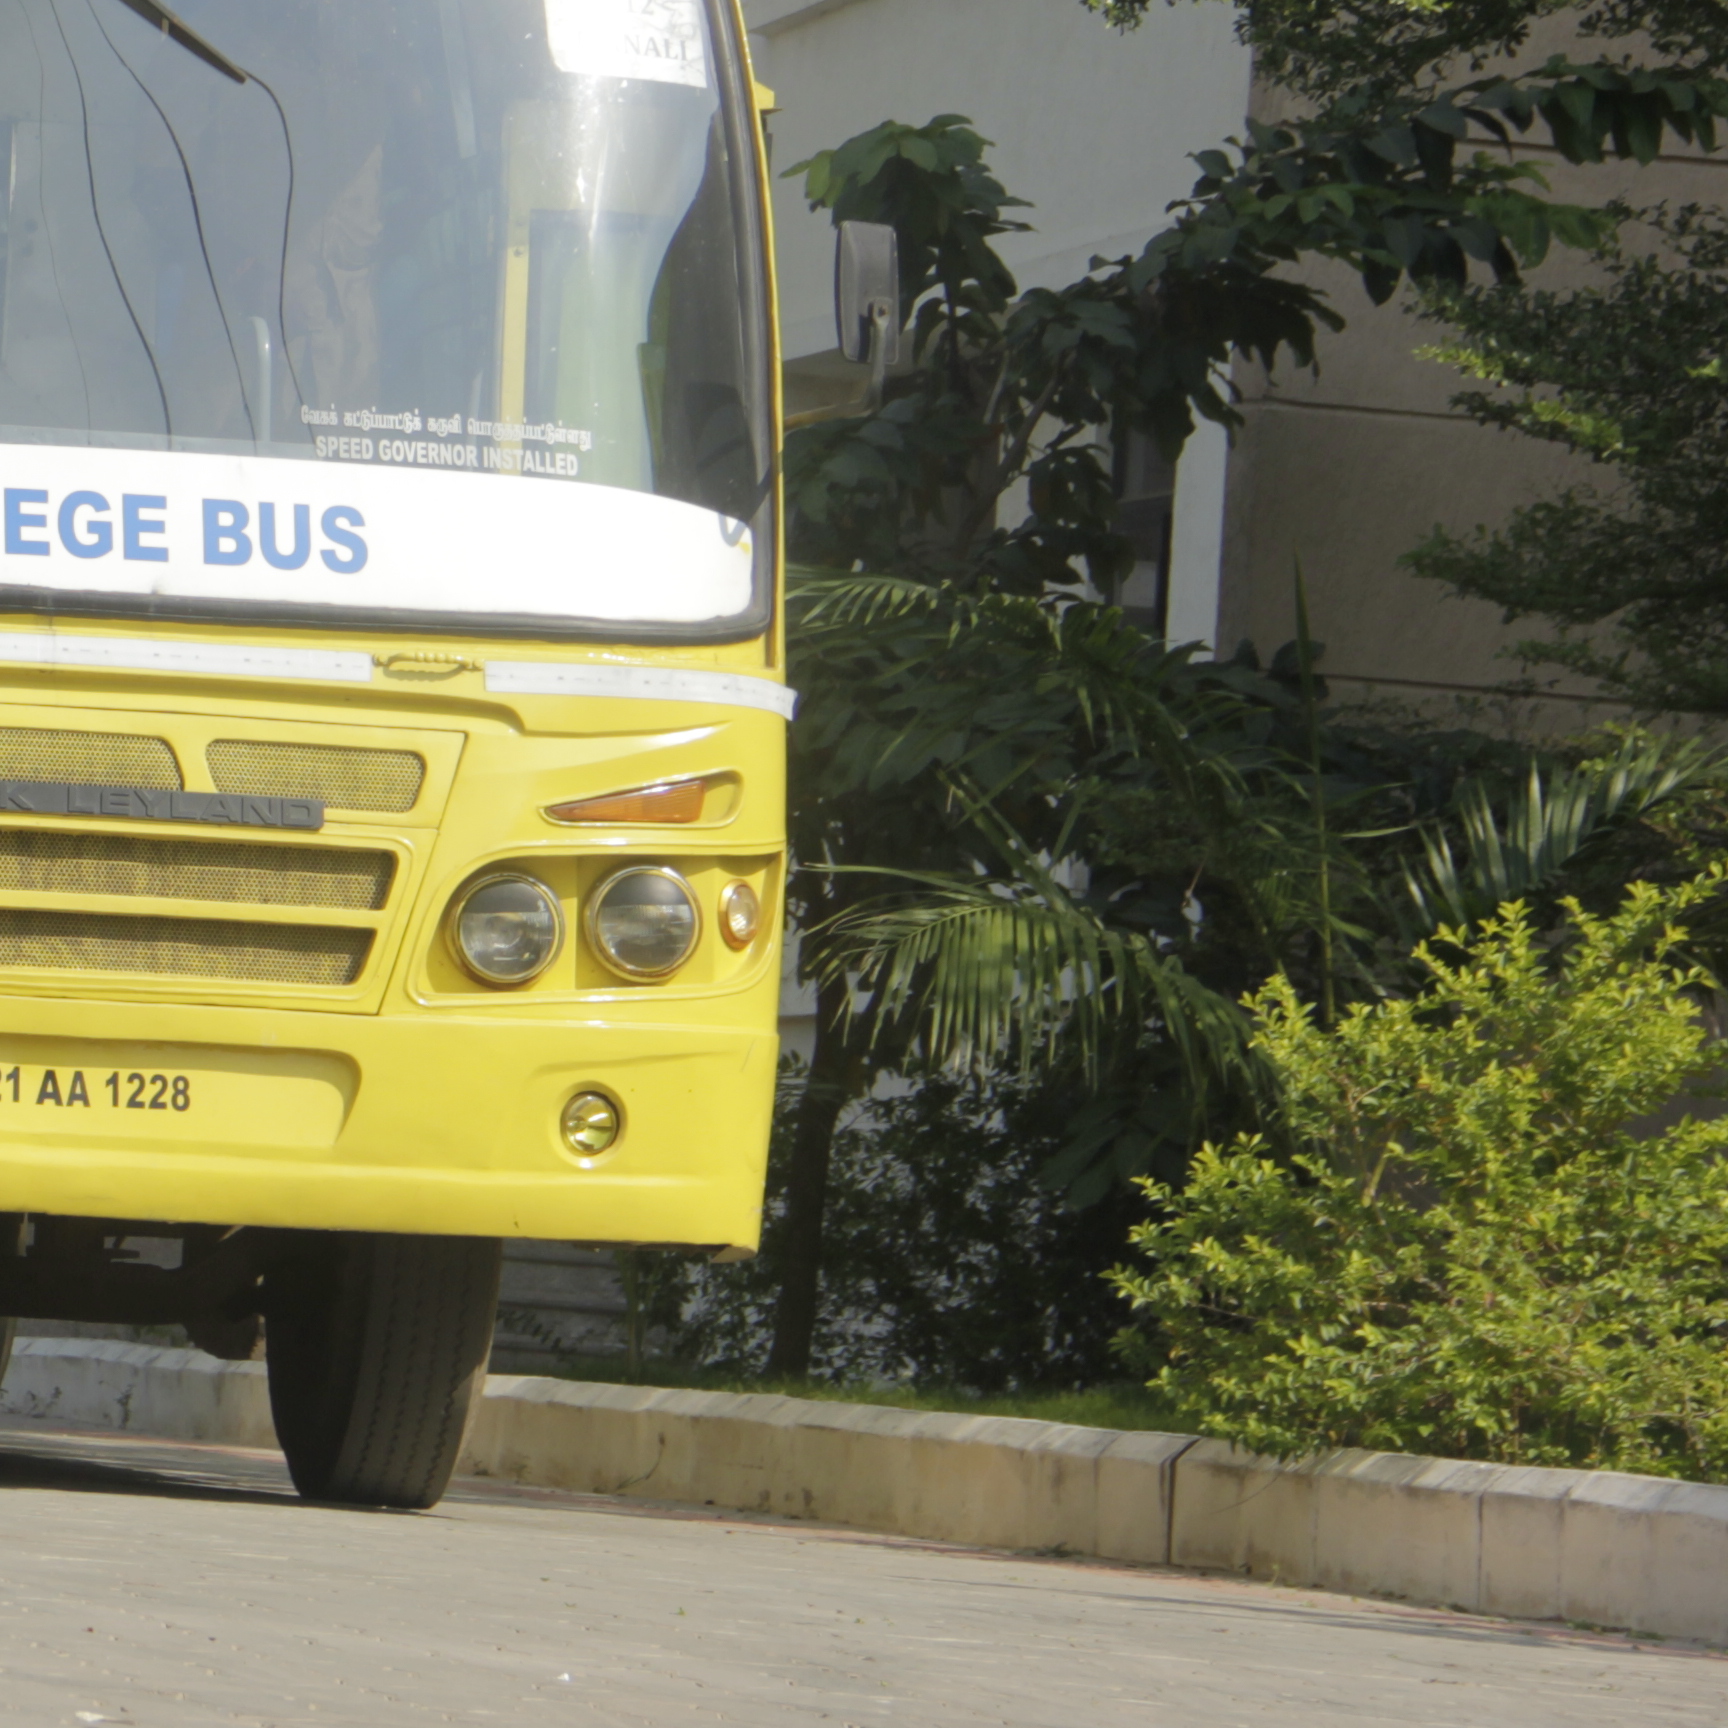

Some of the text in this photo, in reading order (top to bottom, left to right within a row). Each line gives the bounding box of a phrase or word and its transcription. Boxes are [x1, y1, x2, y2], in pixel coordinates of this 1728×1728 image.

[316, 434, 578, 476] SPEED GOVERNOR INSTALLED
[201, 497, 369, 574] BUS
[66, 785, 319, 828] LEYLAND
[36, 1068, 91, 1109] AA
[104, 1070, 192, 1113] 1228
